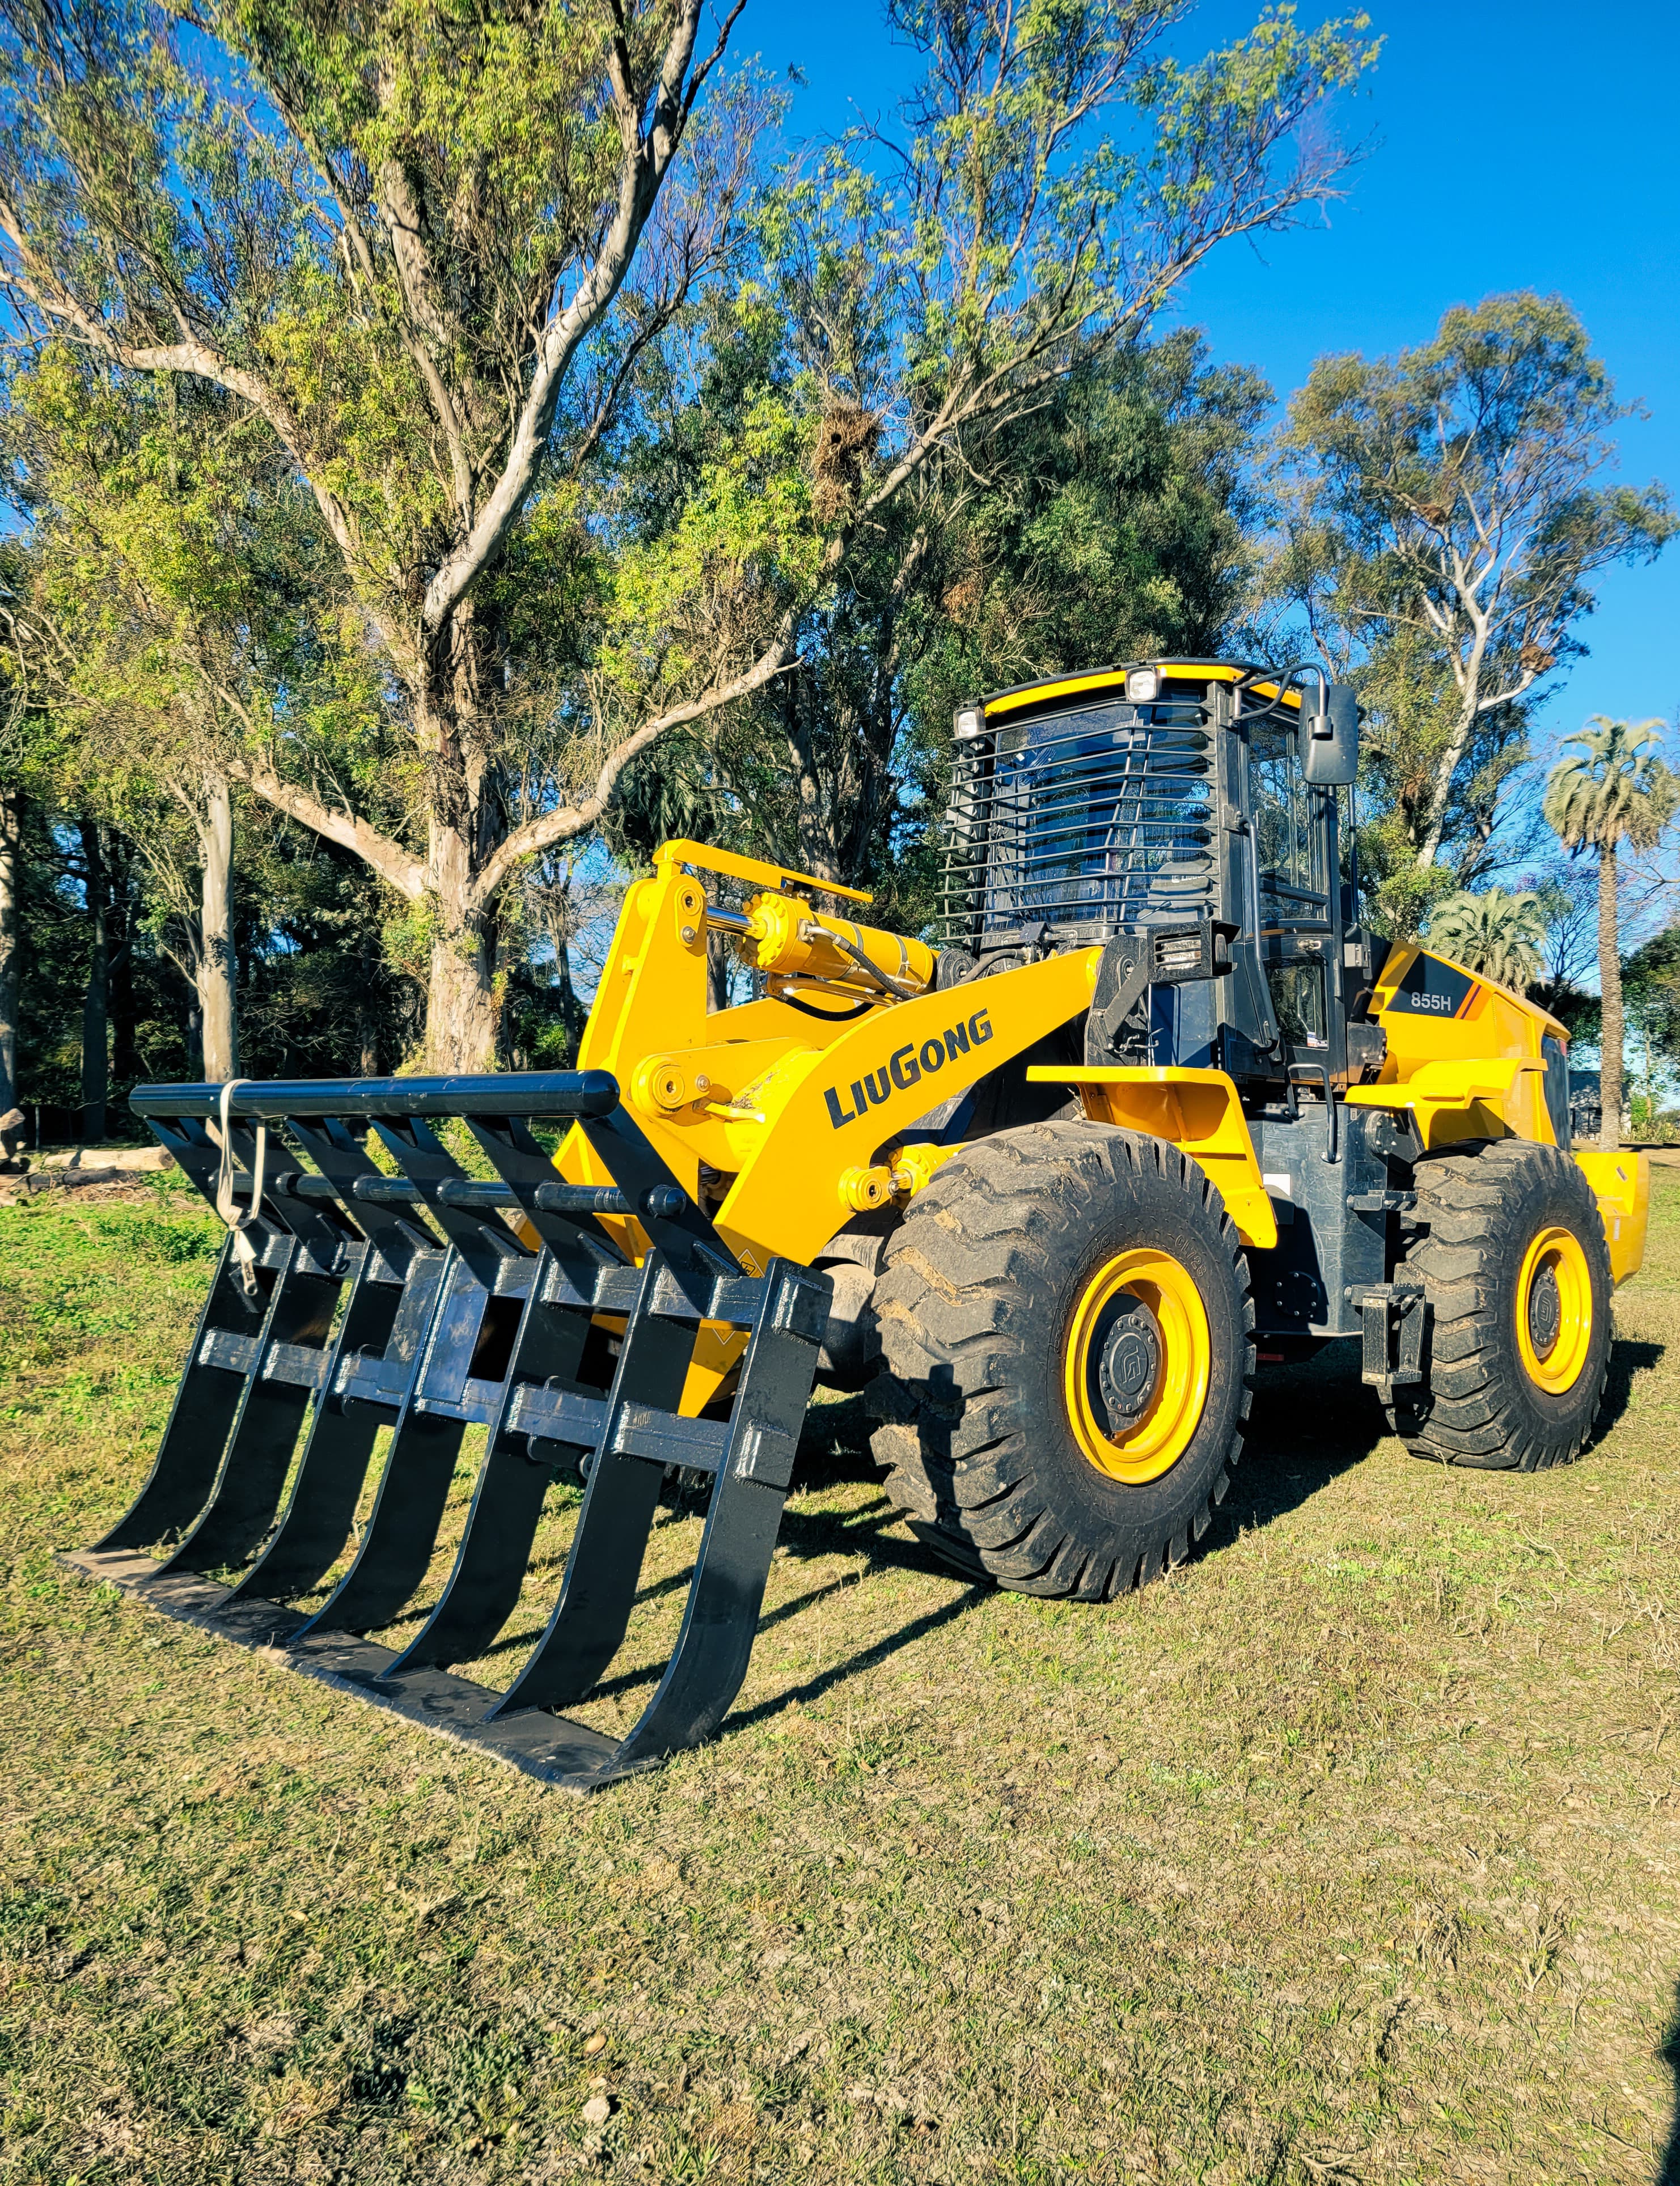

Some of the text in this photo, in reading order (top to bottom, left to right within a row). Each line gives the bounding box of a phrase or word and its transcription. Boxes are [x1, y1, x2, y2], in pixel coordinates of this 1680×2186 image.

[1411, 992, 1452, 1011] 855H
[823, 1007, 994, 1130] LIUGONG
[1175, 1234, 1207, 1277] CL728
